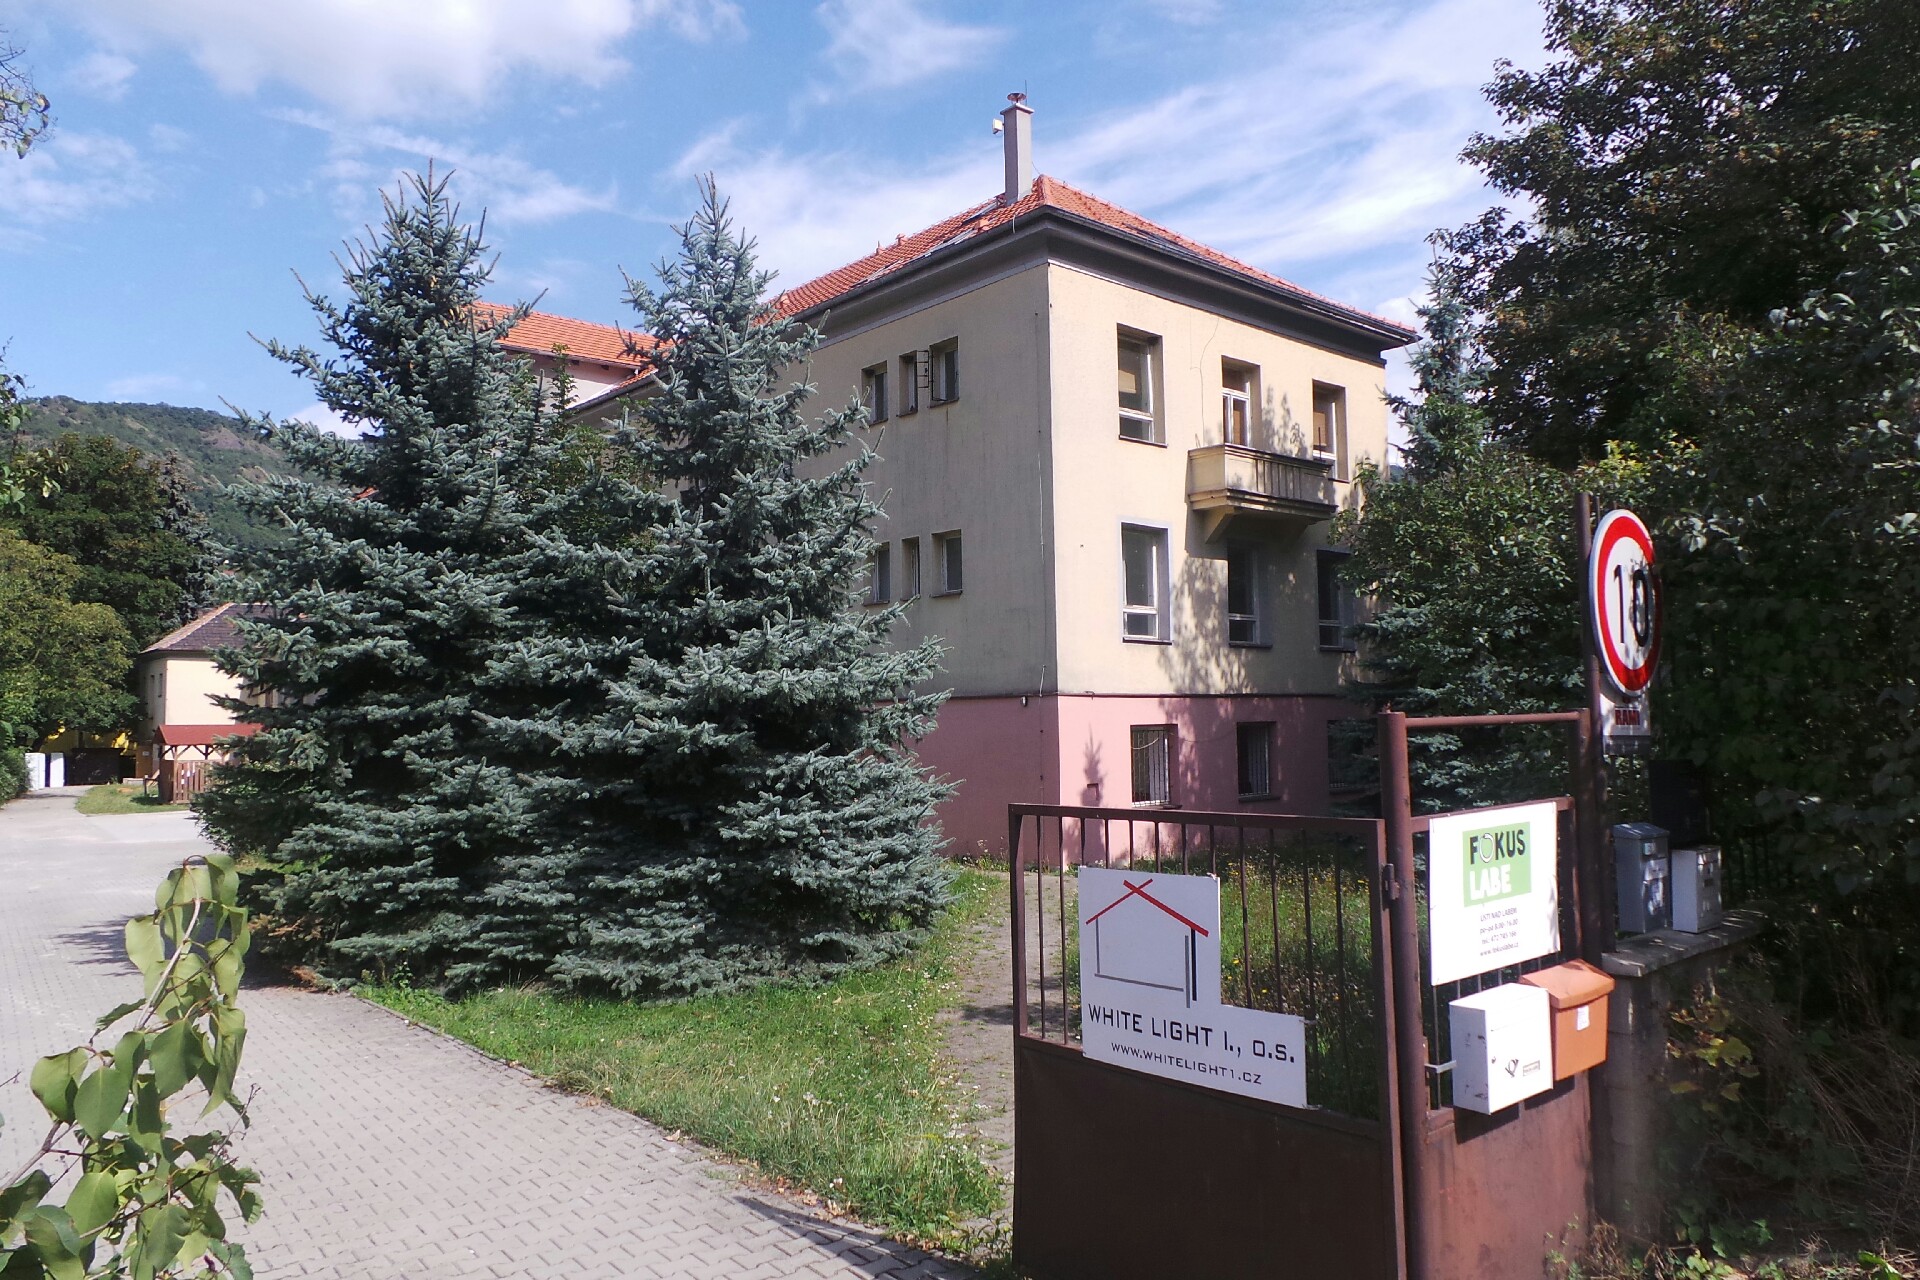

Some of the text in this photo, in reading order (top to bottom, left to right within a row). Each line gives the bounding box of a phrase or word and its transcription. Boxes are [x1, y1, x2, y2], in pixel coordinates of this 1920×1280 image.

[1613, 564, 1649, 647] 10
[1469, 829, 1526, 865] FOKUS
[1469, 863, 1512, 899] LABE
[1088, 1003, 1143, 1034] WHITE
[1151, 1017, 1213, 1047] LIGHT
[1111, 1042, 1262, 1085] WWW.WHITELIGHT1.CZ
